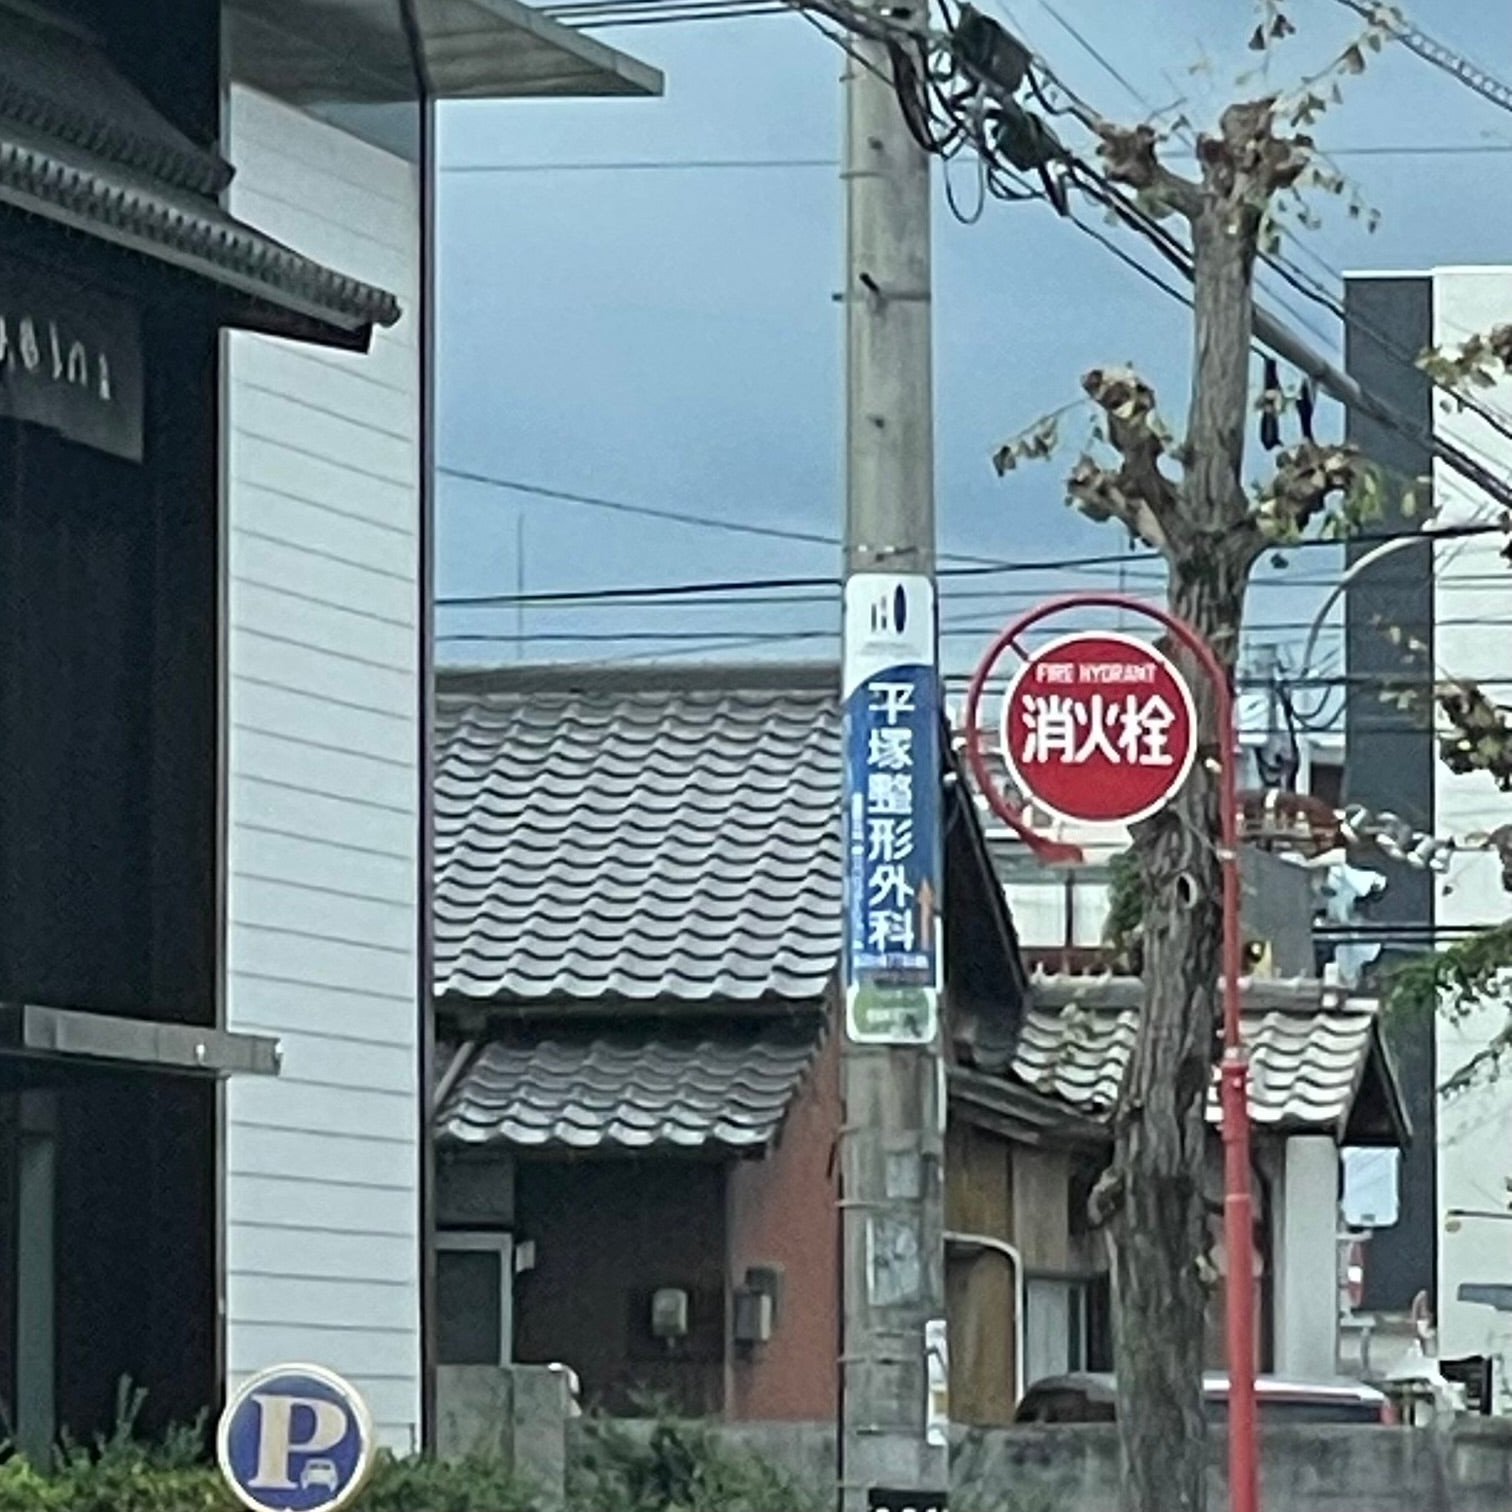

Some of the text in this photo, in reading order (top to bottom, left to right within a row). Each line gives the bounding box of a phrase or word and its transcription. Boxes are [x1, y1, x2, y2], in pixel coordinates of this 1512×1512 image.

[1035, 661, 1157, 684] FIRE HYDRANT
[1021, 694, 1176, 765] 消火栓
[866, 682, 916, 953] 平塚整形外科
[246, 1392, 348, 1490] P
